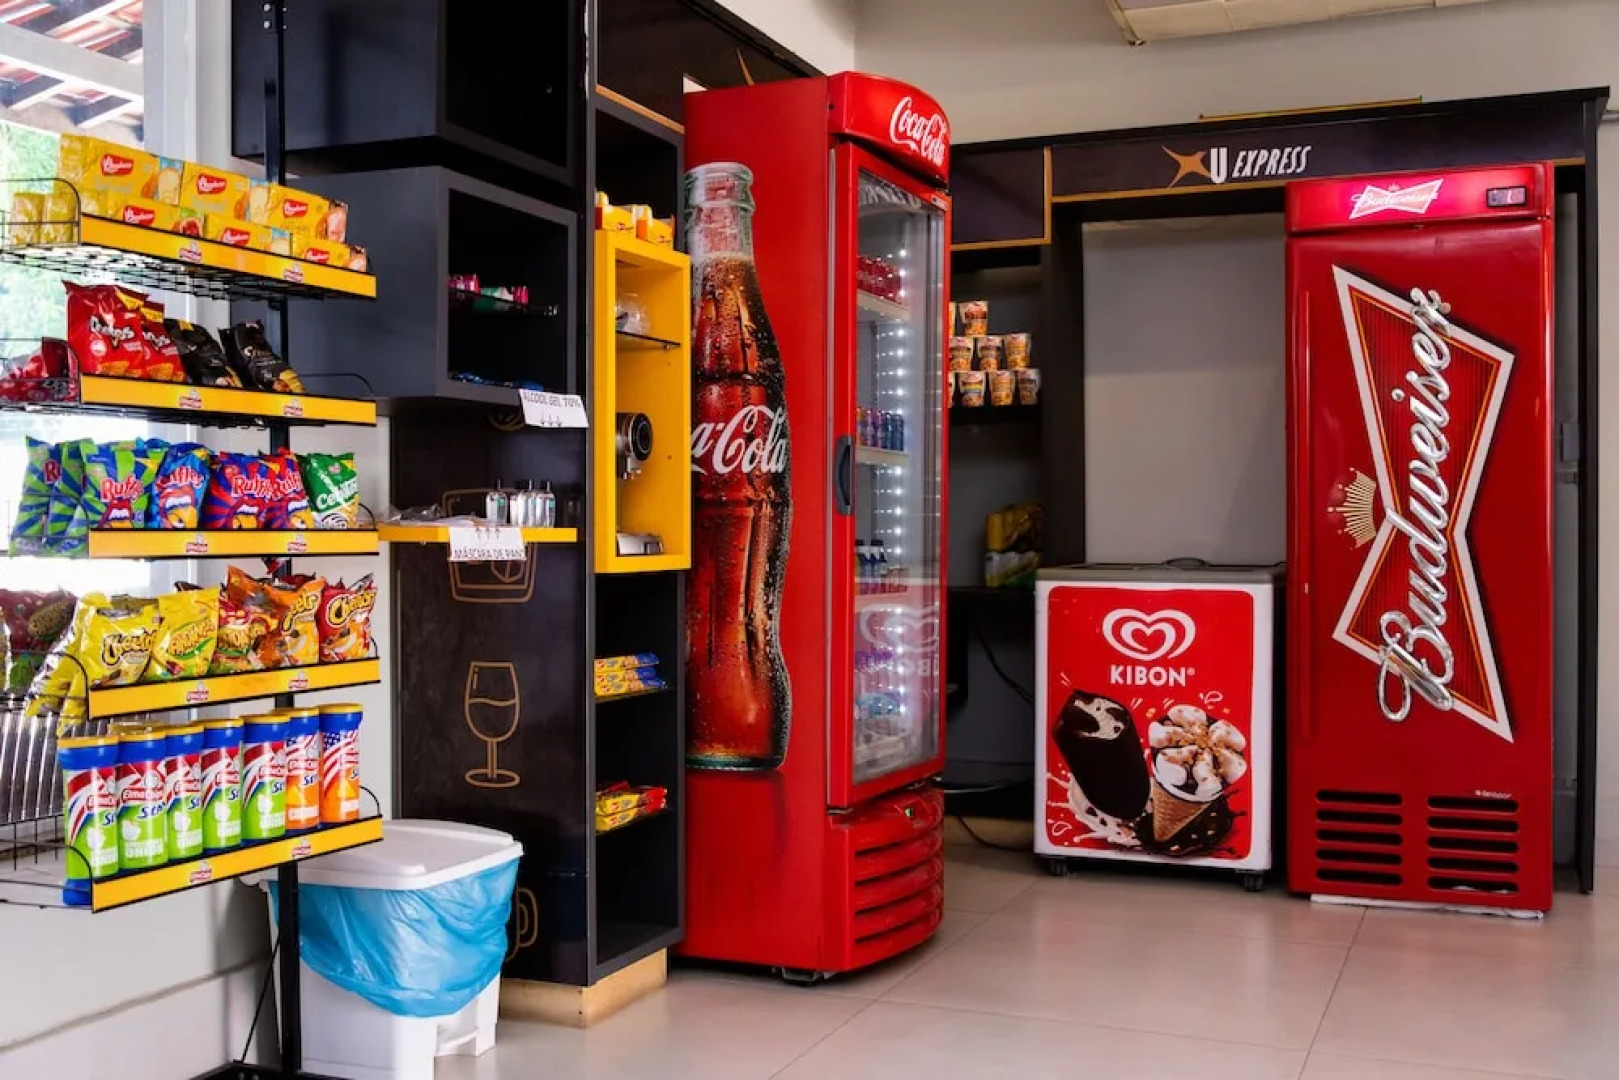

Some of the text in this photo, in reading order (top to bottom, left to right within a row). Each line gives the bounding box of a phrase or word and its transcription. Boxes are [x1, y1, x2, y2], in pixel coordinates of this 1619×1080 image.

[889, 96, 946, 167] Coca-Cola
[1210, 145, 1312, 184] U EXPRESS
[1377, 287, 1454, 722] Budweiser
[1109, 664, 1186, 687] KIBON
